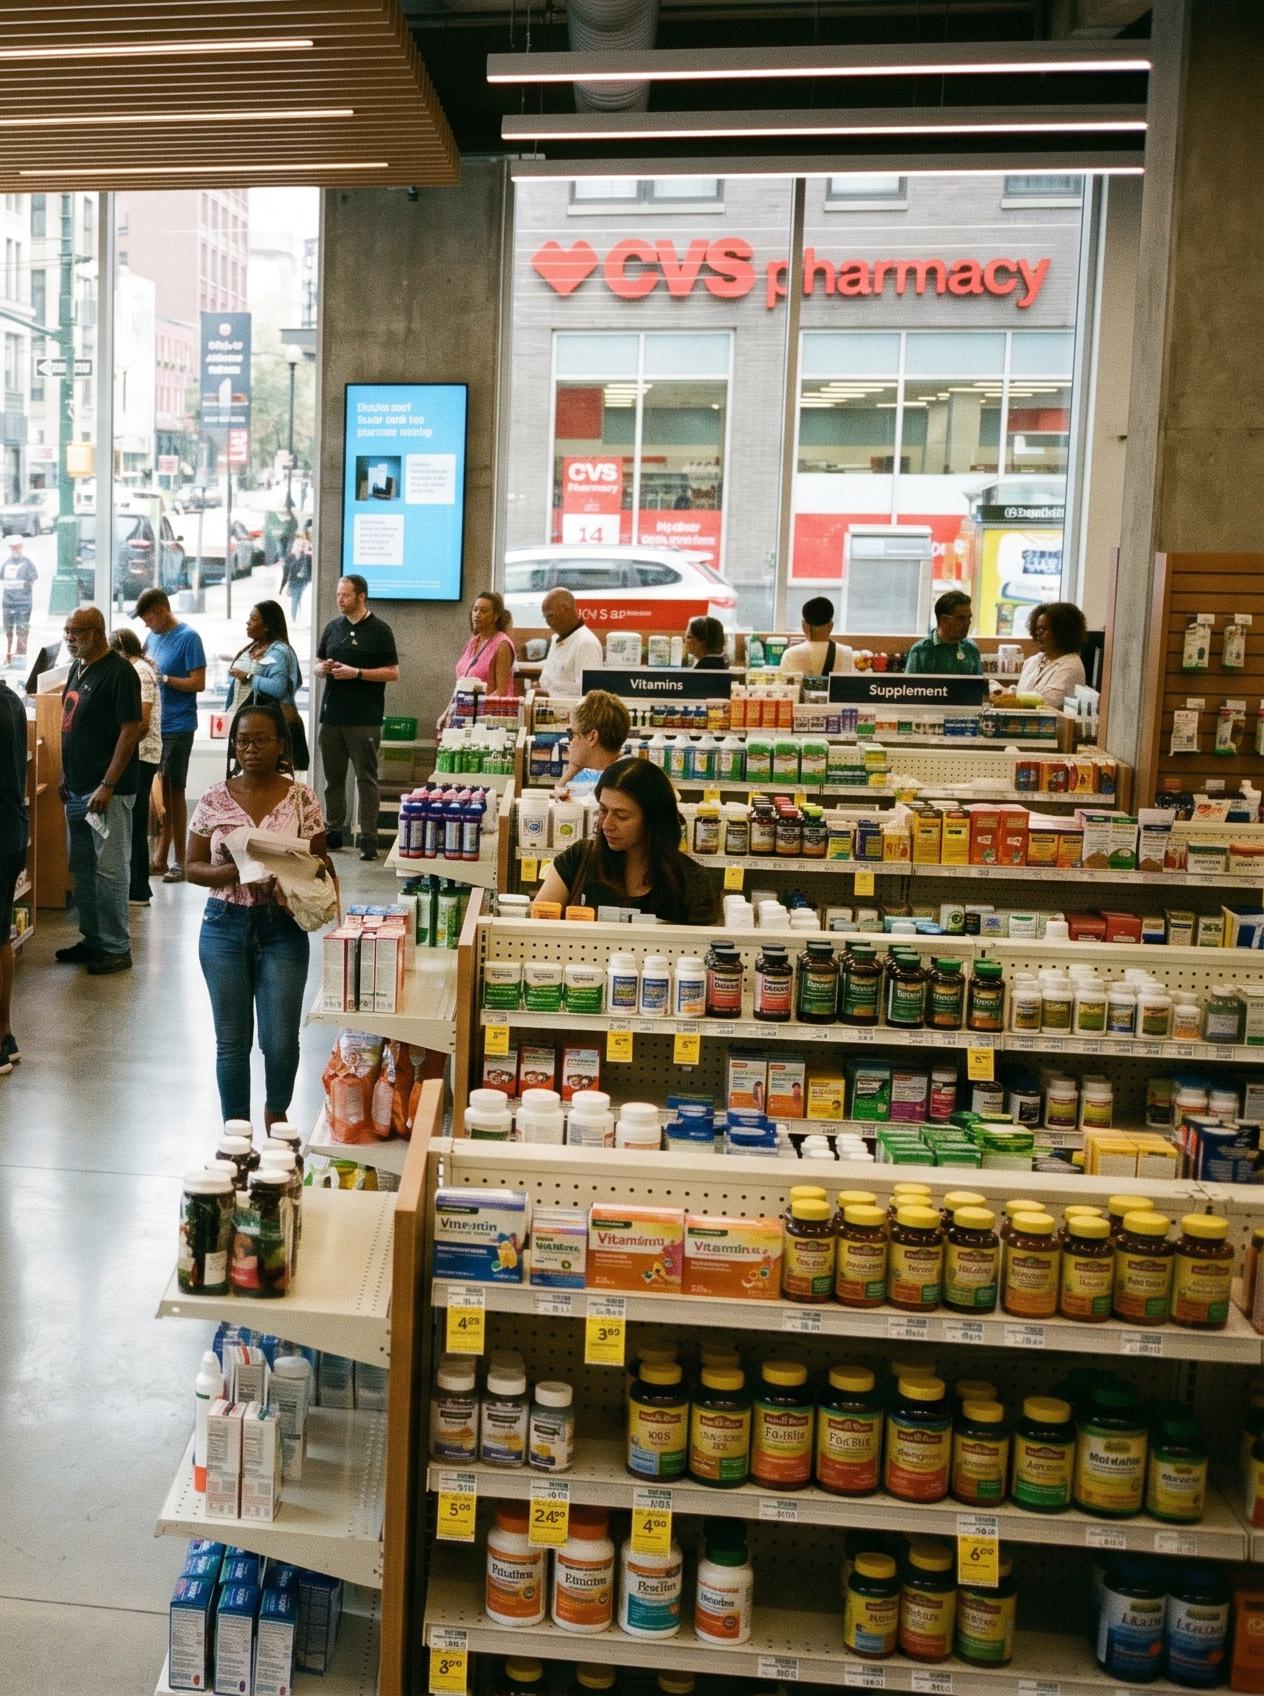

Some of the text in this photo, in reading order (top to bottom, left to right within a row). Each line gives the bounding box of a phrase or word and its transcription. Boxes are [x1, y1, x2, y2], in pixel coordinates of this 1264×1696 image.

[603, 238, 1052, 309] CVS pharmacy
[568, 462, 618, 482] CVS
[578, 527, 604, 543] 14
[630, 677, 684, 691] Vitamins
[868, 684, 948, 699] Supplement
